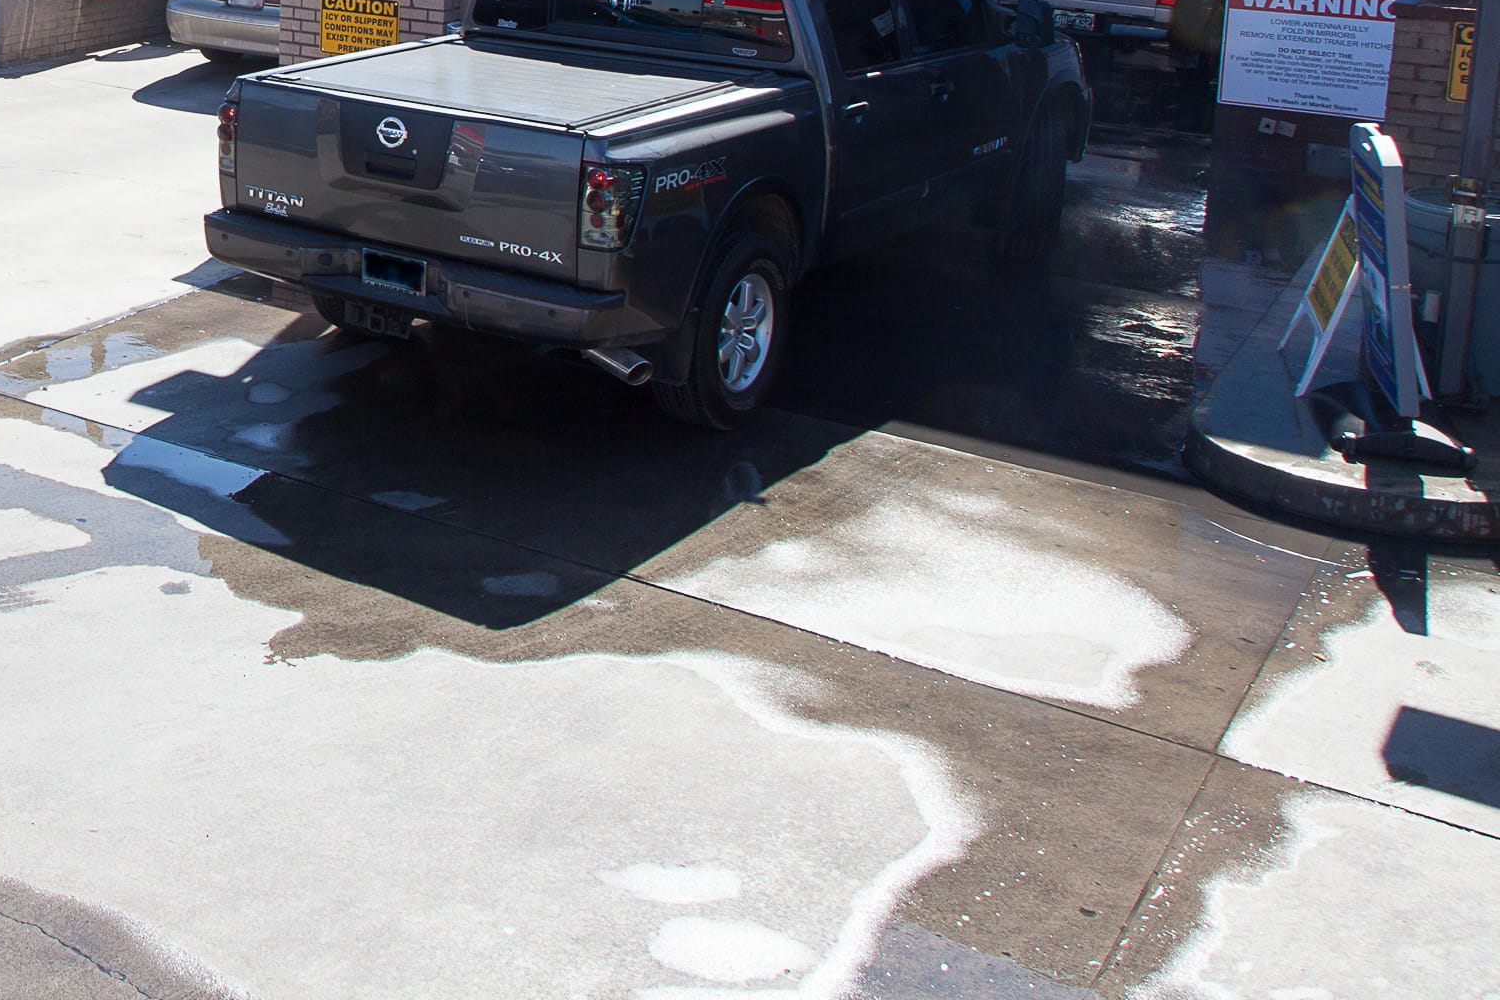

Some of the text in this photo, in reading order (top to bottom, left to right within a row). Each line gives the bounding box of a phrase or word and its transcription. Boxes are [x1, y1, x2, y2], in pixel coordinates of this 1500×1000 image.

[325, 12, 394, 28] ICY OR SLIPPERY
[1270, 18, 1369, 32] LOWER ANTENNA FULLY
[324, 22, 394, 37] CONDITIONS MAY
[1281, 26, 1356, 39] FOLD IN MIRRORS
[326, 33, 391, 47] EXIST ON THESE
[1240, 30, 1275, 40] REMOVE
[1276, 33, 1321, 44] EXTENDED
[1323, 38, 1359, 47] TRAILER
[245, 184, 304, 208] TITAN
[499, 241, 563, 265] PRO-4X
